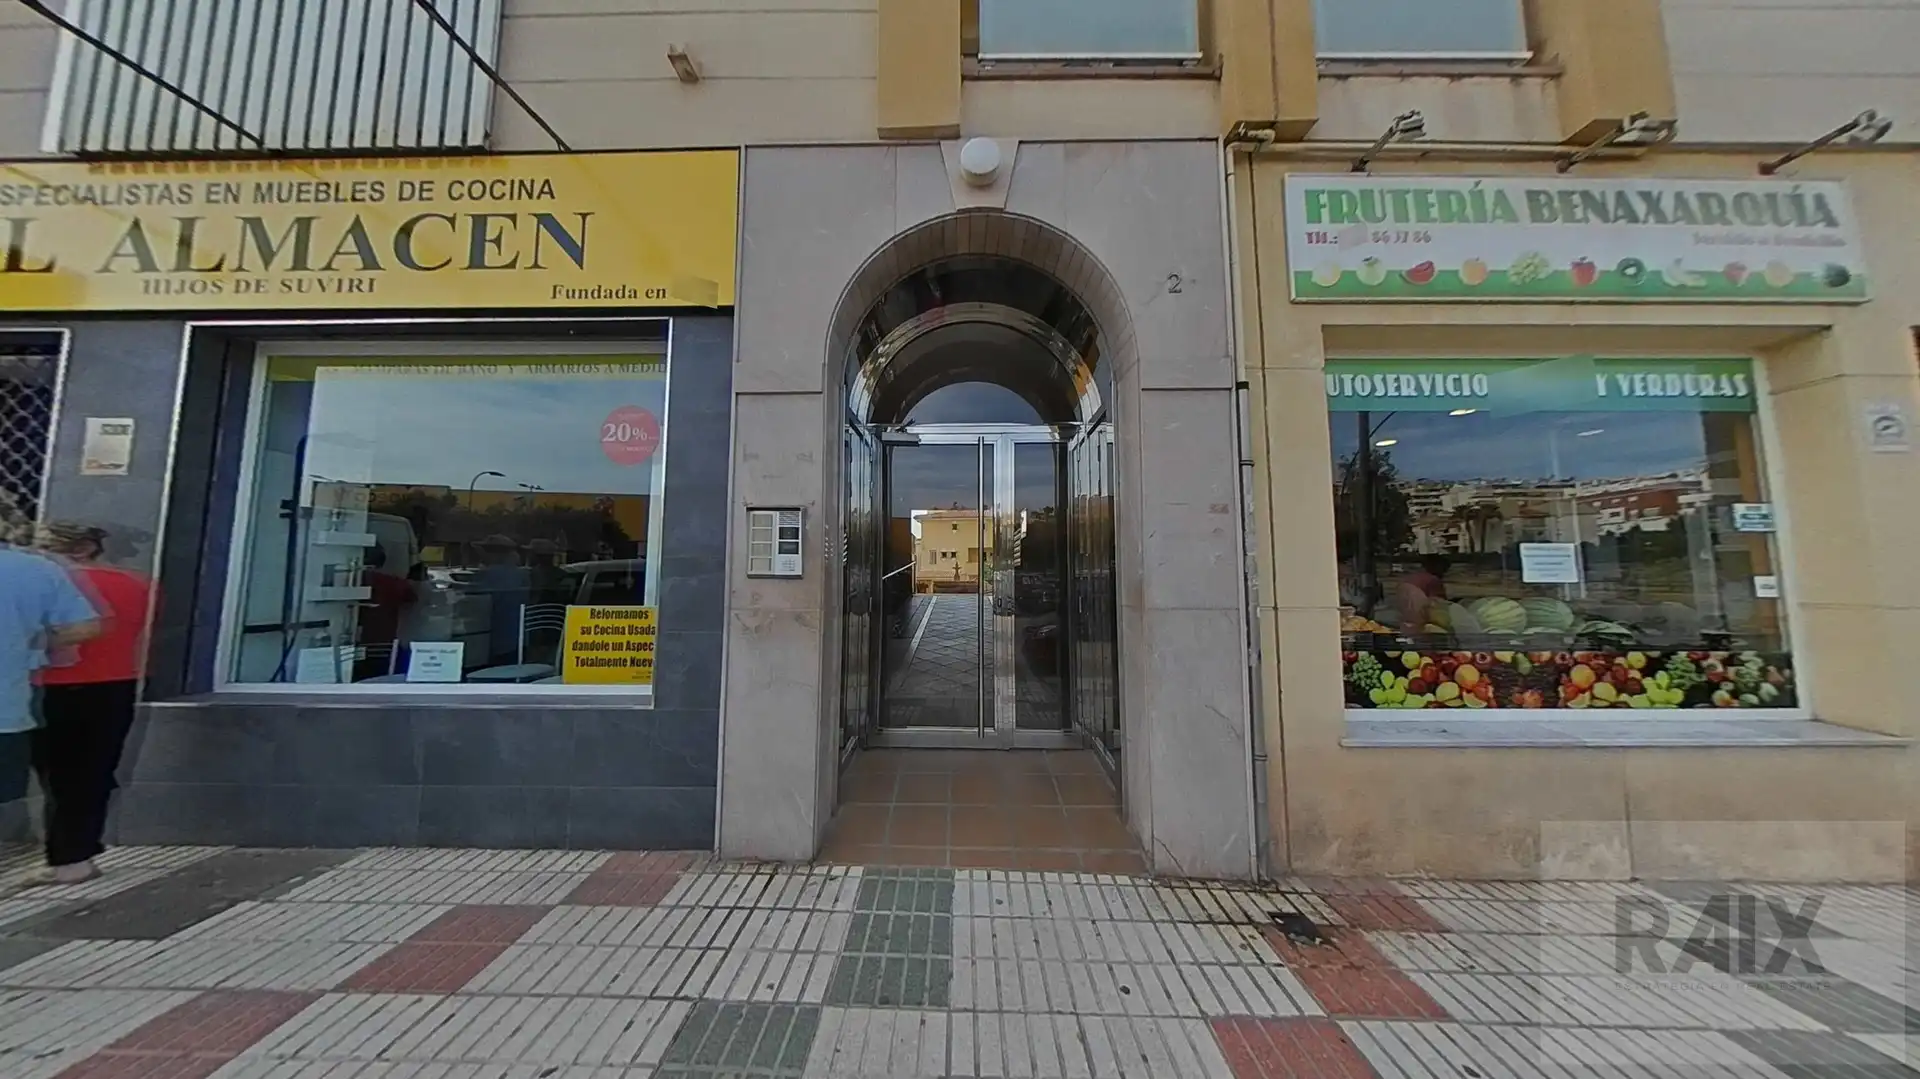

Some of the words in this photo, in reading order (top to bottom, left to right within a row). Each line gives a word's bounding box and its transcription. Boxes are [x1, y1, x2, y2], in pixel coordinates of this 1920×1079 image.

[205, 181, 241, 205] EN
[253, 180, 386, 204] MUEBLES
[398, 180, 435, 201] DE
[448, 178, 556, 201] COCINA
[1304, 179, 1520, 224] FRUTERÍA
[1525, 184, 1841, 228] BENAXARQUÍA
[0, 216, 57, 273] L
[95, 211, 596, 274] ALMACEN
[143, 278, 224, 295] HIJOS
[233, 278, 269, 294] DE
[279, 277, 376, 294] SUVIRI
[551, 284, 638, 300] Fundada
[645, 287, 668, 299] en
[1168, 273, 1182, 294] 2
[525, 362, 601, 375] ARMARIOS
[1326, 373, 1489, 398] UTOSERVICIO
[1620, 373, 1749, 398] VERDURAS
[590, 608, 649, 620] Reformamos
[580, 625, 591, 635] su
[594, 624, 626, 636] Cocina
[628, 624, 656, 636] Usada
[572, 640, 610, 652] dandole
[612, 641, 624, 652] un
[575, 656, 627, 668] Totalmente
